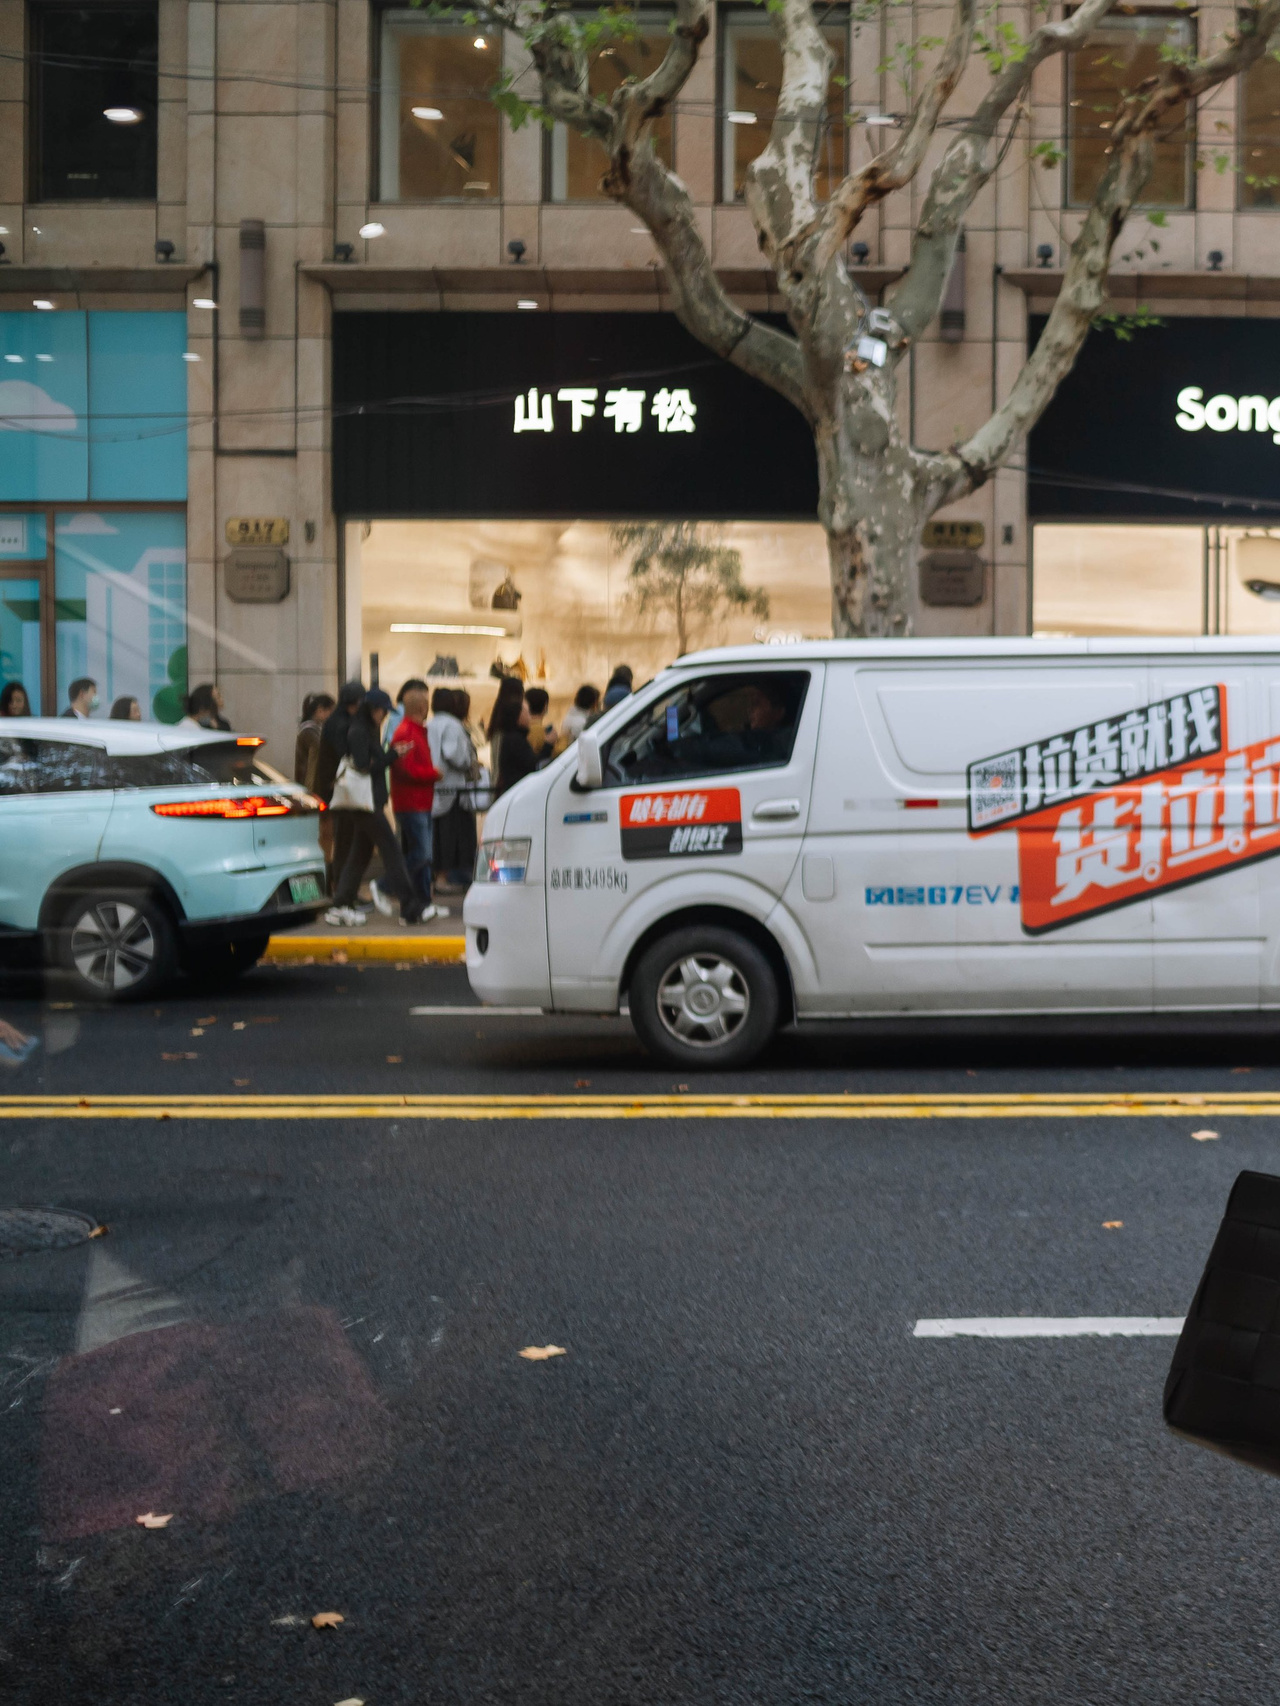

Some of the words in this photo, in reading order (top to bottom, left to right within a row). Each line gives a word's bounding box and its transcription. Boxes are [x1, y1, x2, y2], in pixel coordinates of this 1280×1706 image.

[513, 387, 698, 433] 山下有松
[1023, 686, 1220, 811] 拉货就找
